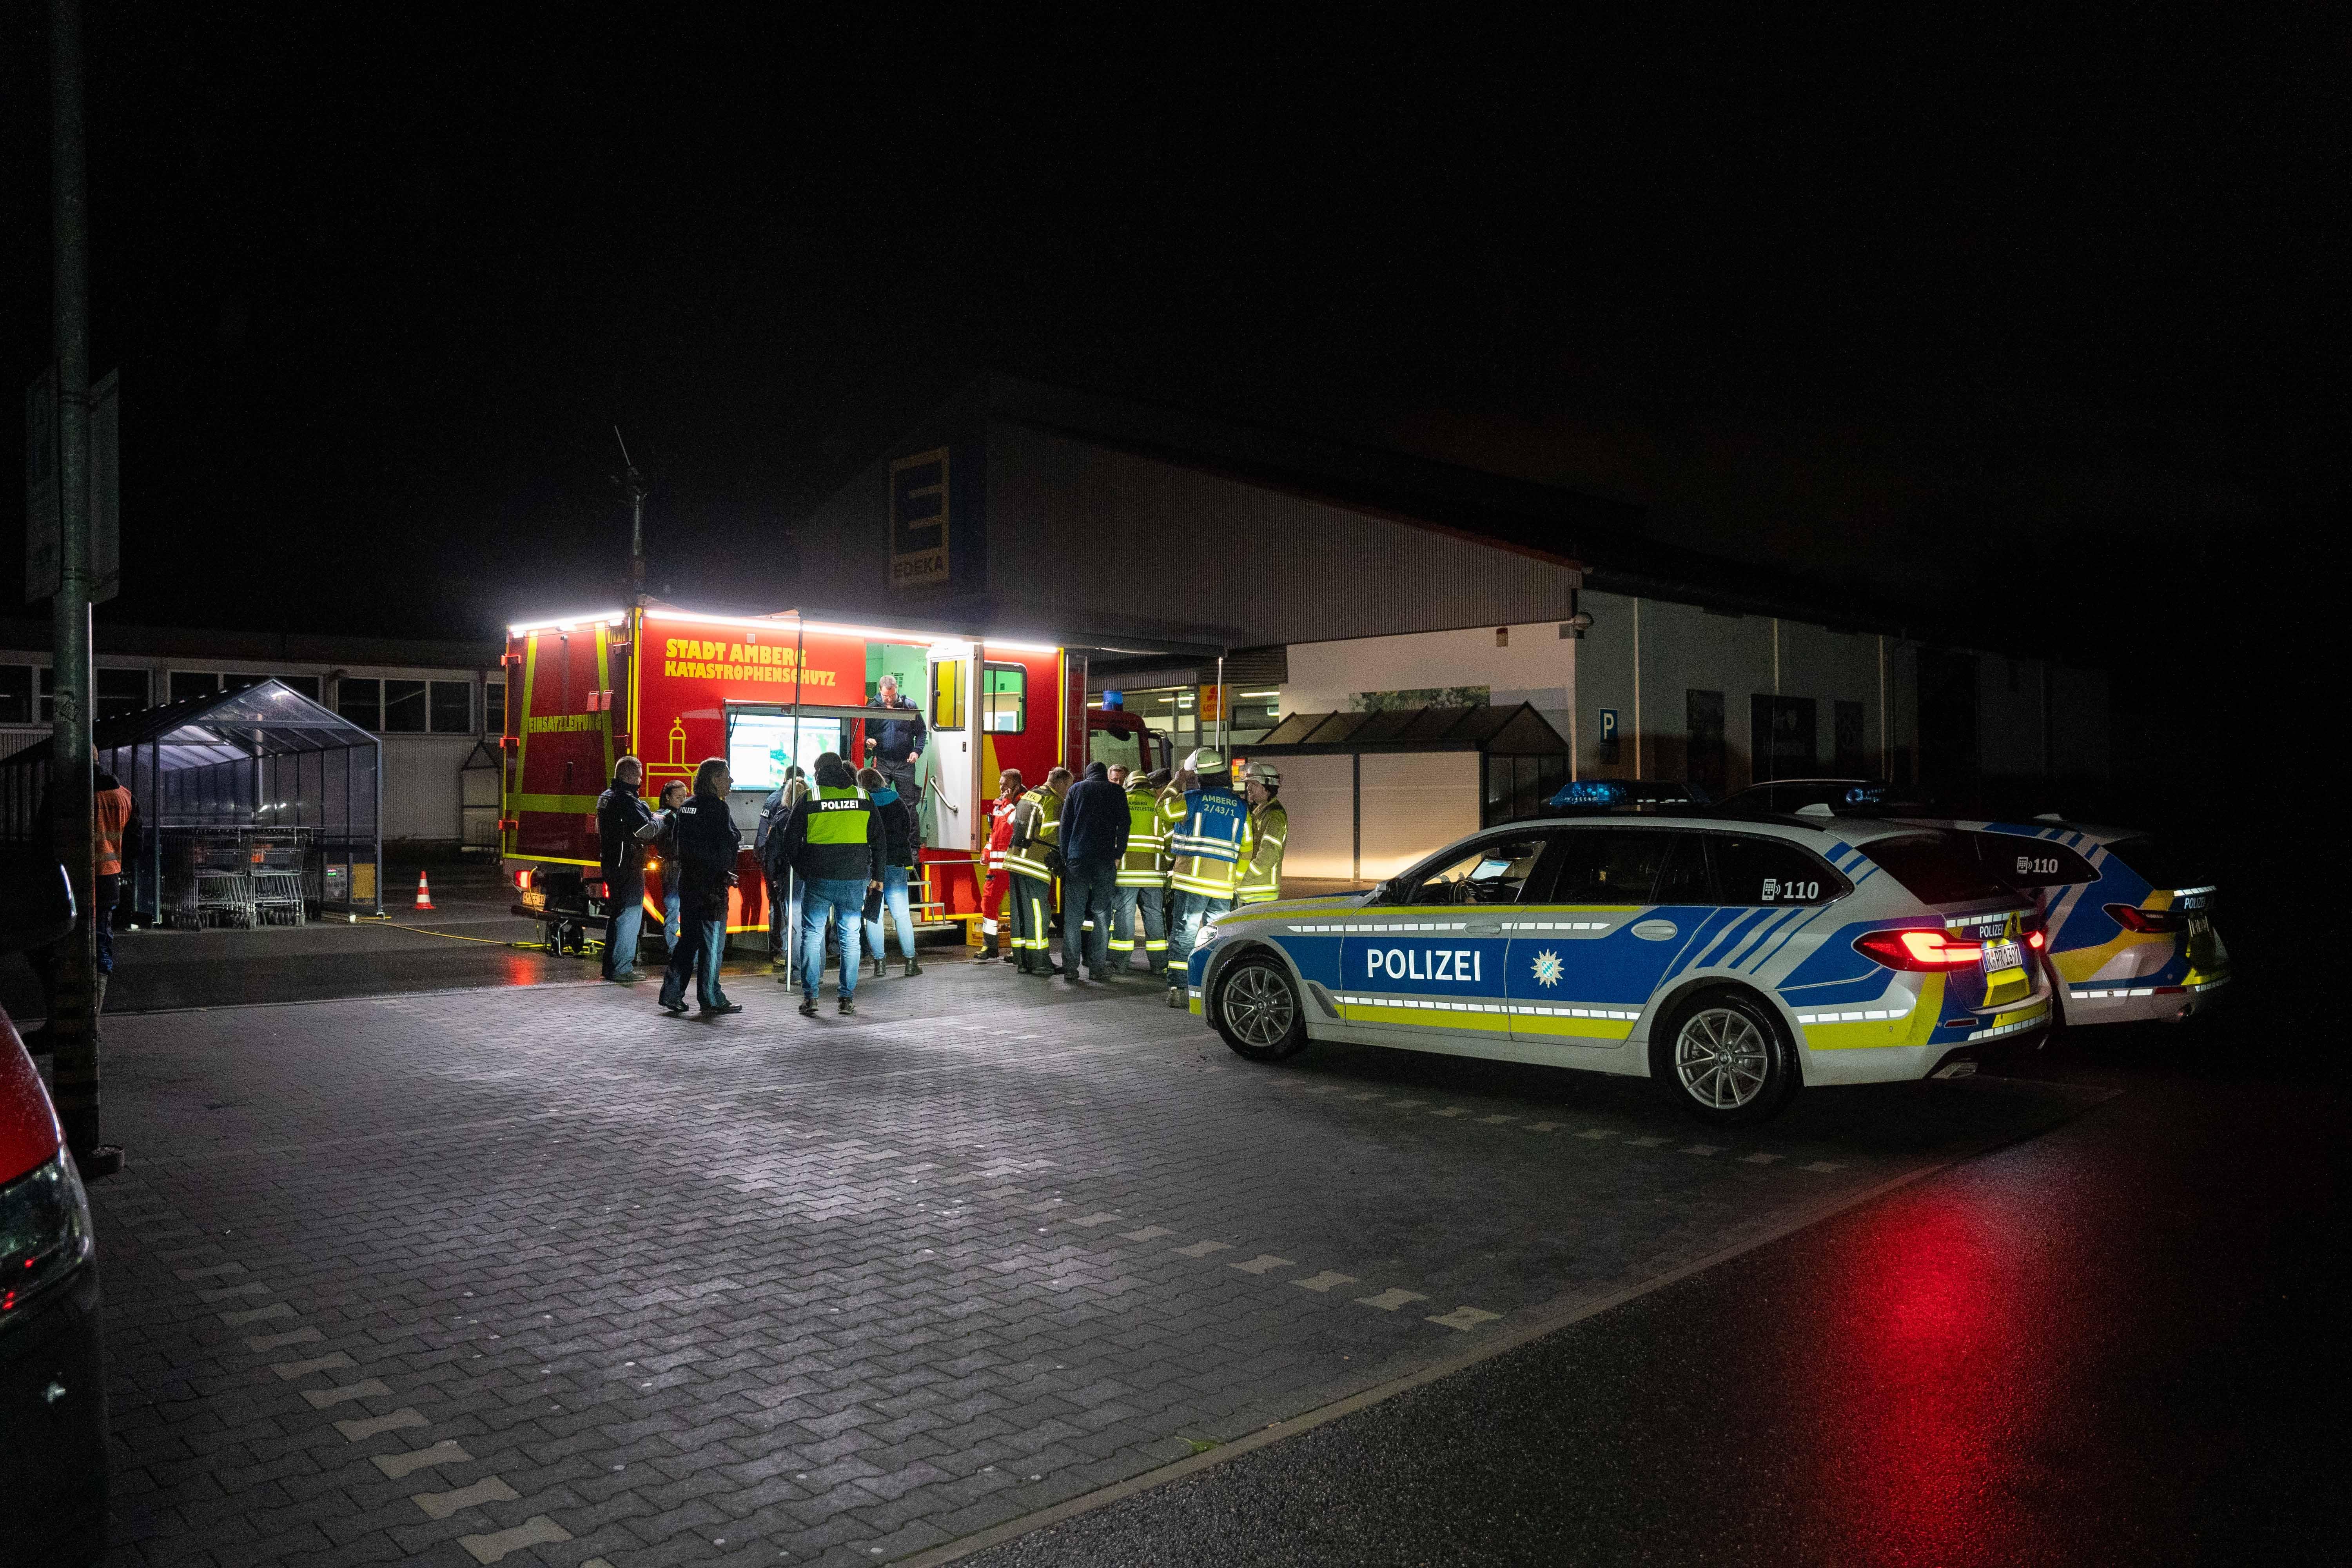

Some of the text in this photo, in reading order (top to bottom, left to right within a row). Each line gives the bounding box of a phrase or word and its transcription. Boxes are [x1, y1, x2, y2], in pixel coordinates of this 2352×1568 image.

[894, 556, 943, 579] EDEKA
[666, 639, 806, 667] STADT AMBERG
[665, 661, 836, 686] KATASTROPHENSCHUTZ
[529, 714, 602, 733] EINSATZLEITUNG
[1604, 713, 1614, 739] P
[821, 800, 858, 810] POLIZEI
[1202, 795, 1237, 806] AMBERG
[1204, 804, 1234, 816] 2/43/1
[2033, 858, 2058, 873] 110
[1784, 882, 1818, 899] 110
[1980, 924, 2003, 938] POLIZEI
[1368, 949, 1480, 981] POLIZEI
